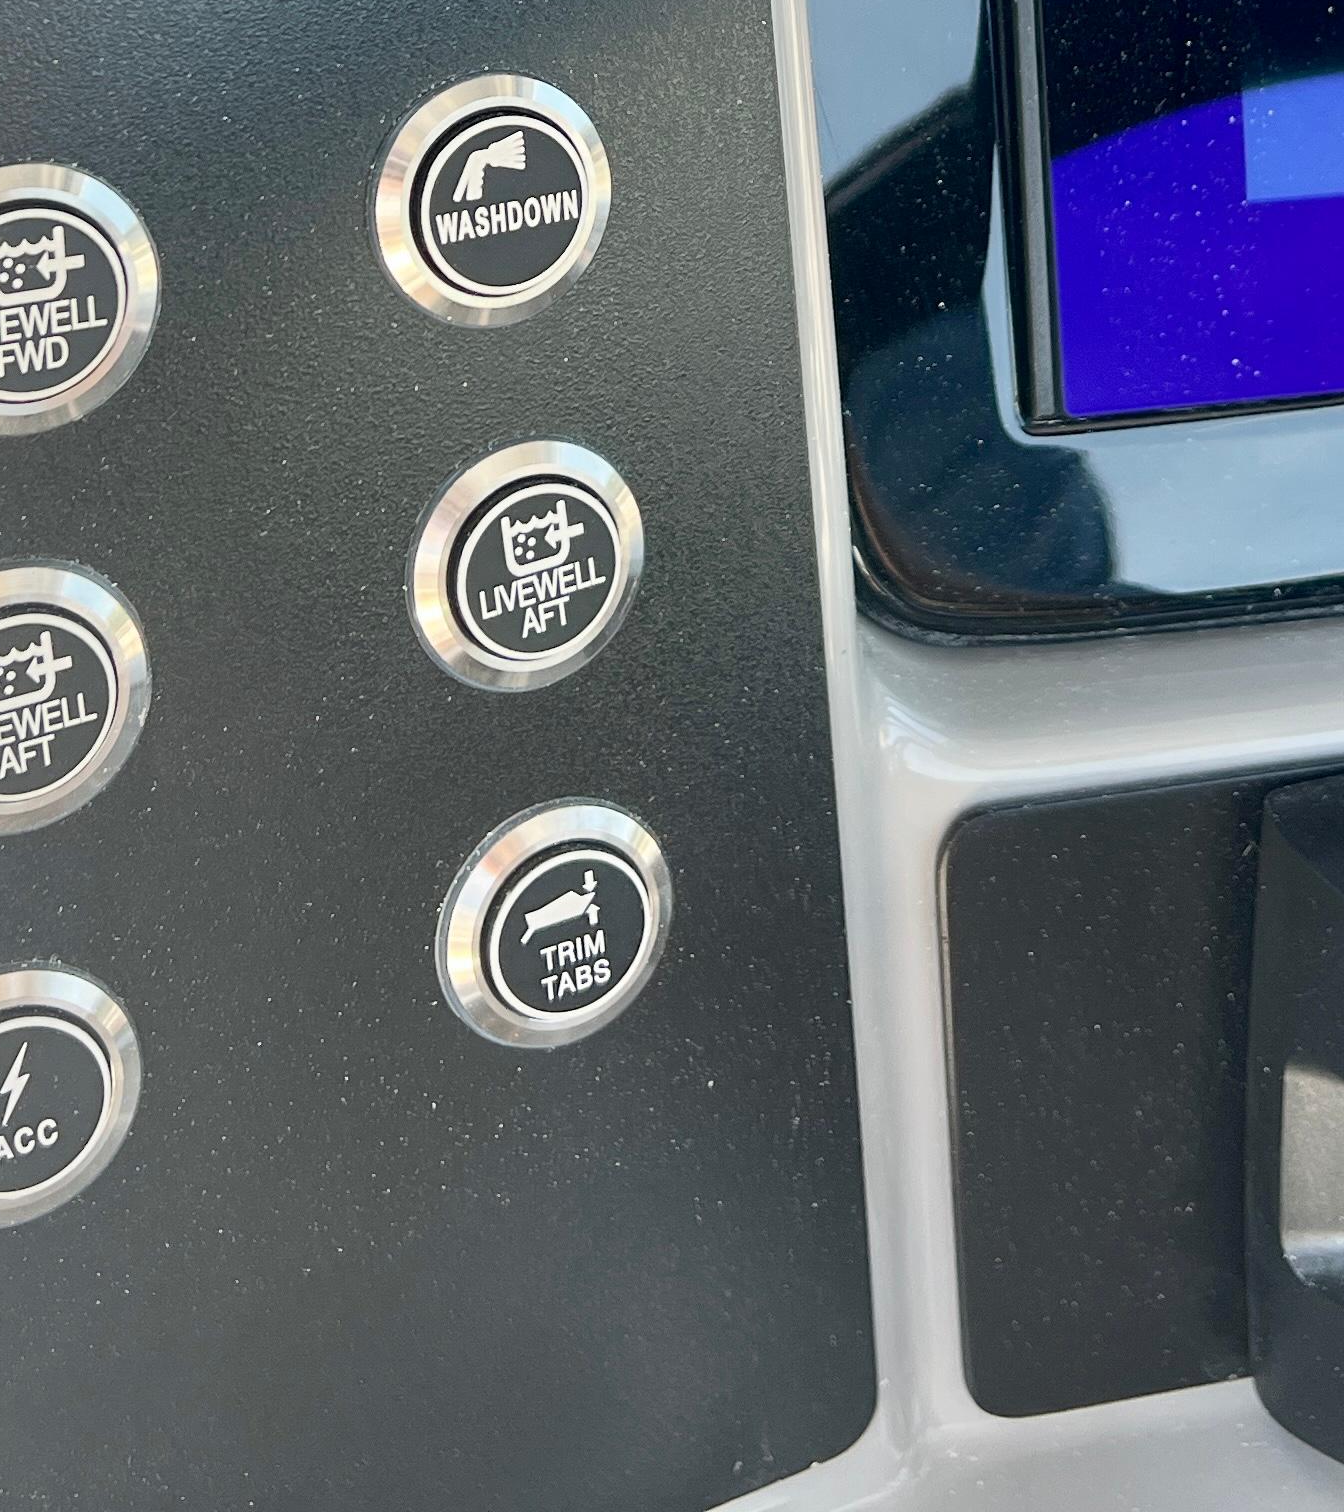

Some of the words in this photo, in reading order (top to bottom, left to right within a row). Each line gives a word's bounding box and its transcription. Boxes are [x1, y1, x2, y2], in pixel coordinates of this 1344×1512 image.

[435, 189, 579, 245] WASHDOWN
[479, 556, 607, 620] LIVEWELL
[522, 595, 570, 639] AFT
[0, 733, 55, 779] AFT
[540, 929, 606, 971] TRIM
[540, 958, 612, 1001] TABS
